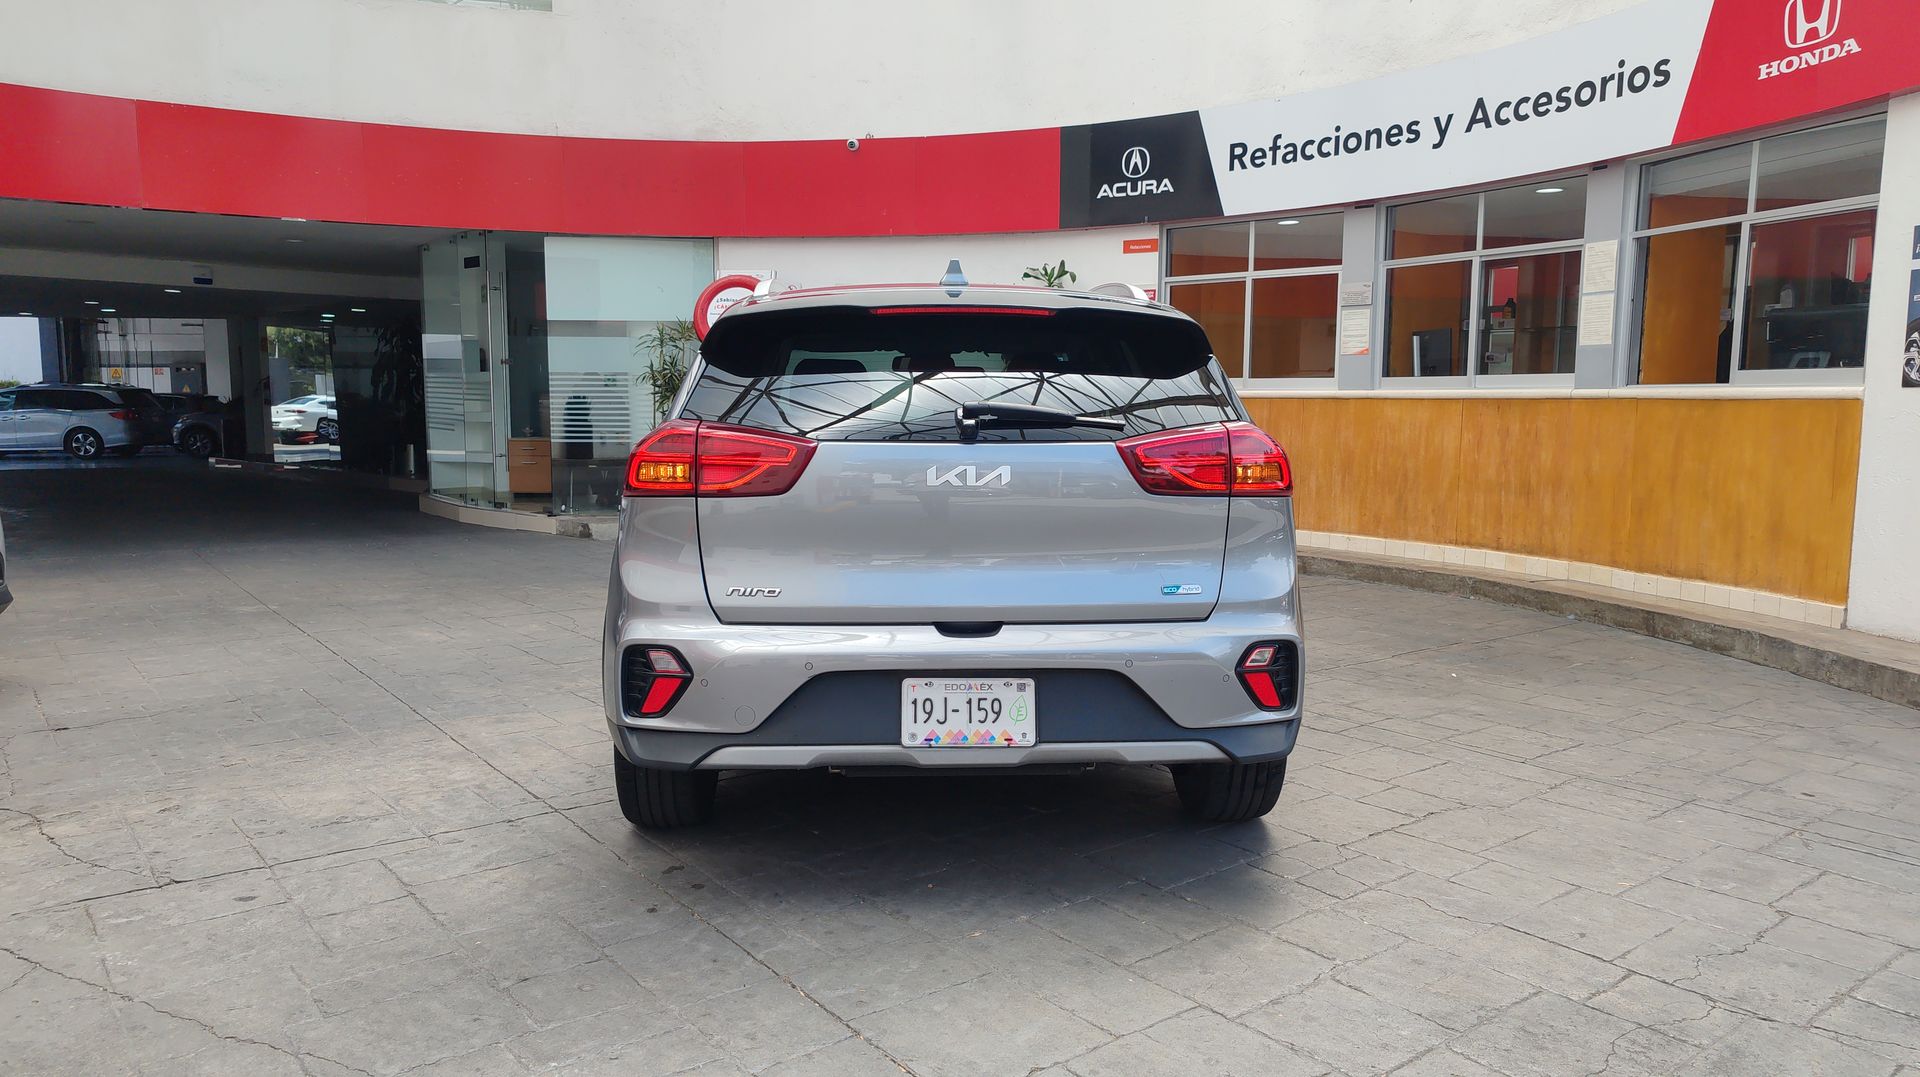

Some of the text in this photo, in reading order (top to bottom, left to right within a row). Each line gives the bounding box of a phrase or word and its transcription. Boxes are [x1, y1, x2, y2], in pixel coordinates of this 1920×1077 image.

[1757, 37, 1862, 80] HONDA
[1228, 57, 1672, 172] Refacciones y Accesorios
[1096, 177, 1175, 199] ACURA
[926, 465, 1012, 487] KIA
[725, 586, 782, 598] niro
[911, 696, 1003, 725] 19J-159
